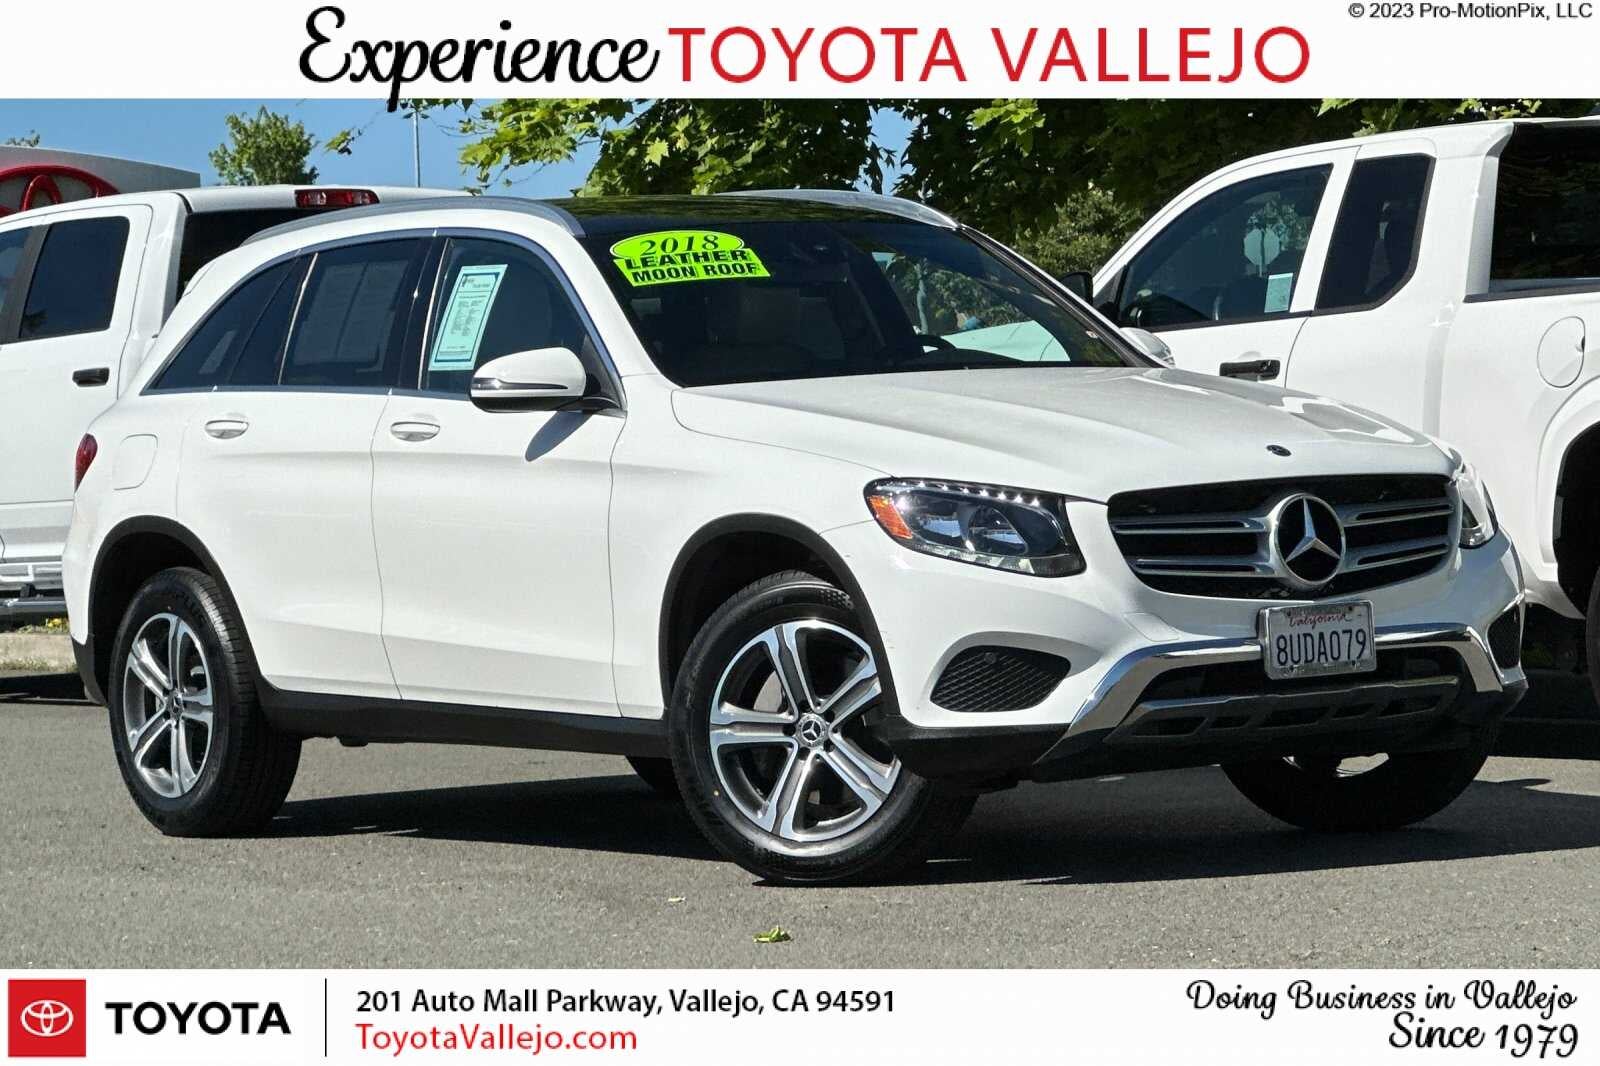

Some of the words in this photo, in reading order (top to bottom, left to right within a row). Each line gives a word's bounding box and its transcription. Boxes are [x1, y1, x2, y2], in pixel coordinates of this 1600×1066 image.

[639, 233, 720, 257] 2018
[624, 249, 749, 270] LEATHER
[631, 265, 697, 283] MOON
[703, 261, 760, 277] ROOF
[1288, 612, 1345, 629] California
[1276, 628, 1367, 666] 8UDA079
